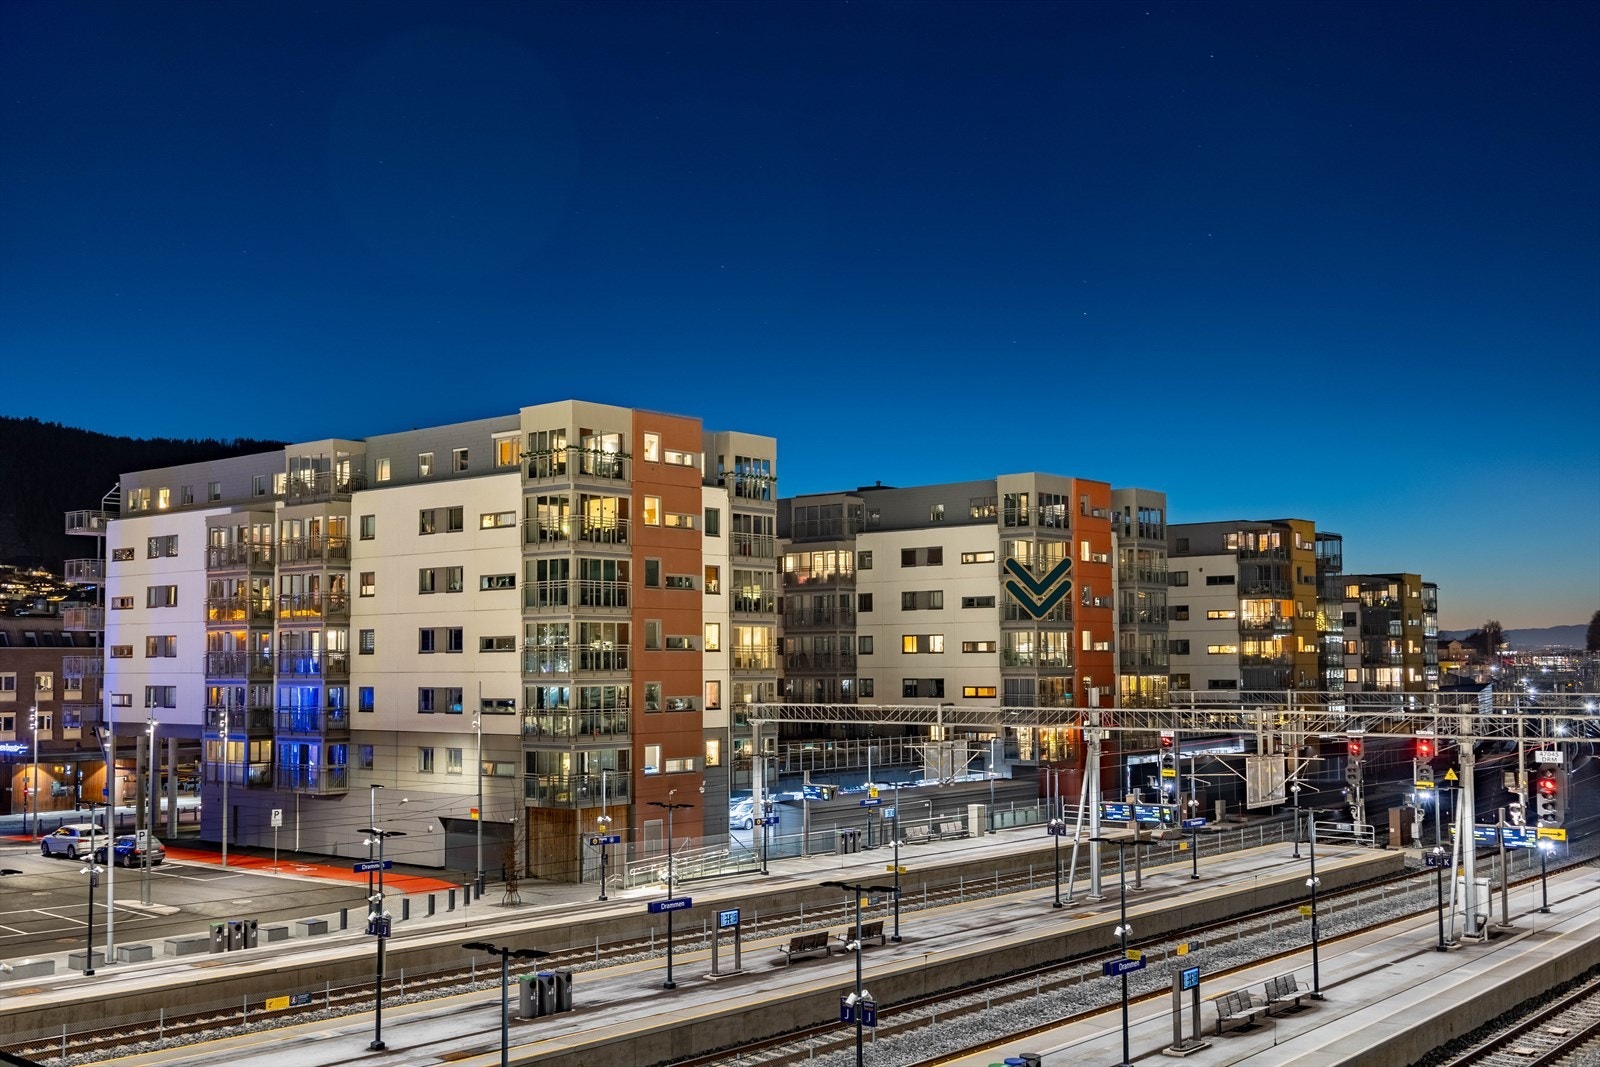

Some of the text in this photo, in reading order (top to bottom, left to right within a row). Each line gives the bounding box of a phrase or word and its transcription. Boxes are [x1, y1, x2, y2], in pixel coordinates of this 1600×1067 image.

[274, 811, 280, 820] P
[139, 831, 146, 841] P
[1060, 828, 1065, 836] K
[1444, 859, 1450, 867] K
[661, 902, 685, 911] Drammen
[1119, 960, 1140, 972] Drammen
[844, 1009, 850, 1020] J
[866, 1012, 871, 1023] J
